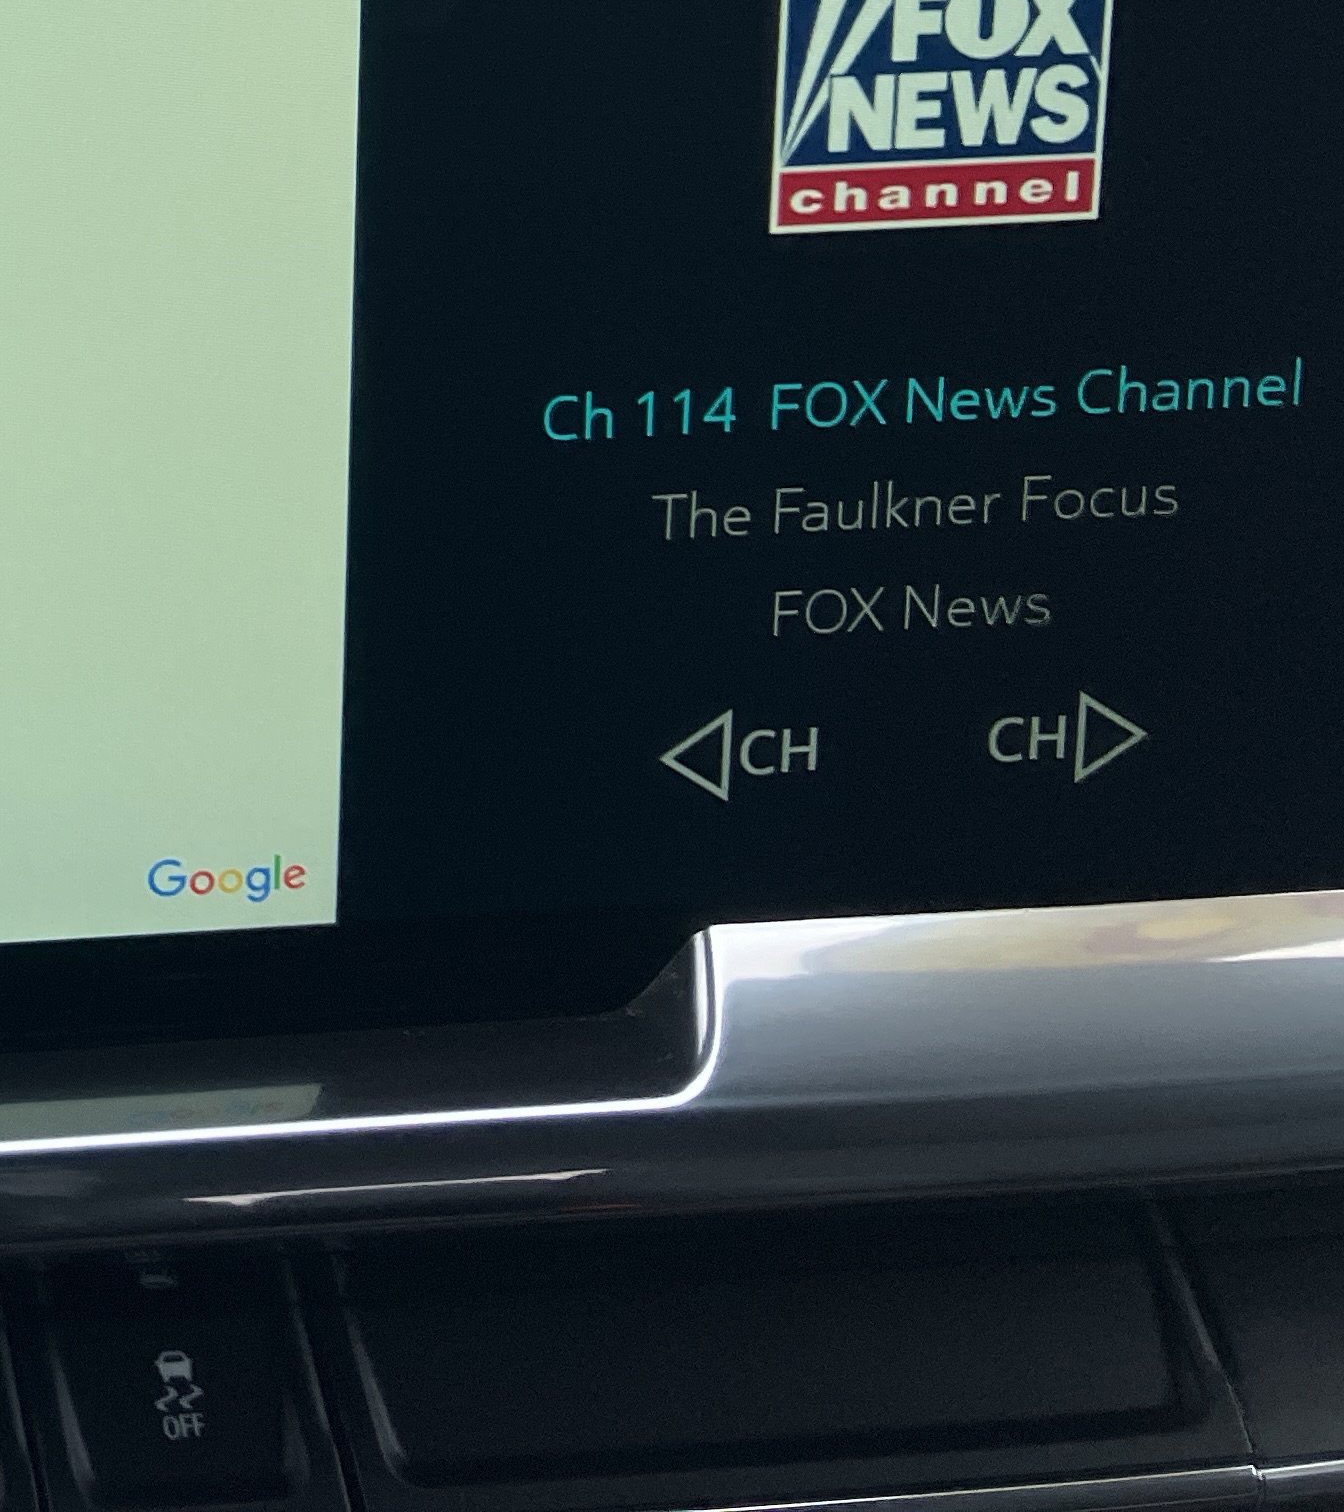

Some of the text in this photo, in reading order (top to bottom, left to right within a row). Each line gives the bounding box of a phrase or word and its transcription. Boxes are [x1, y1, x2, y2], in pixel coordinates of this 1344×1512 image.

[827, 64, 1090, 153] NEWS
[790, 170, 1081, 214] channel
[543, 356, 1304, 441] Ch 114 FOX News Channel
[652, 475, 1180, 541] The Faulkner Focus
[772, 583, 1052, 637] FOX News
[739, 726, 819, 776] CH
[987, 714, 1068, 763] CH
[147, 853, 307, 903] Google
[162, 1412, 205, 1440] OFF
